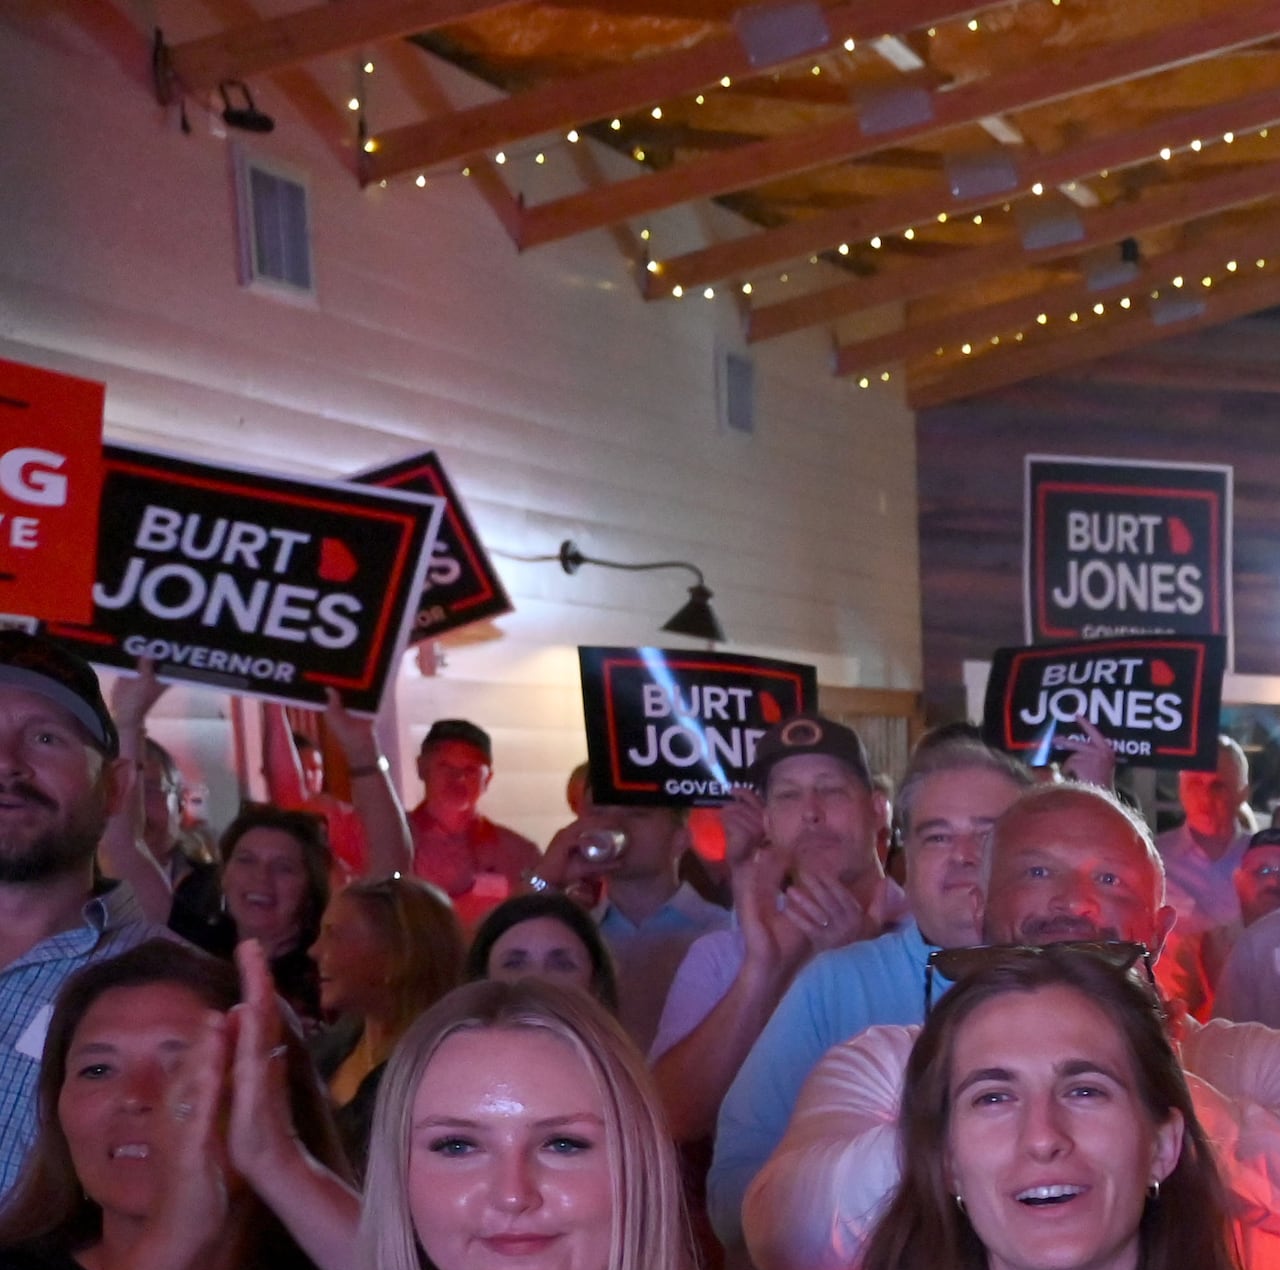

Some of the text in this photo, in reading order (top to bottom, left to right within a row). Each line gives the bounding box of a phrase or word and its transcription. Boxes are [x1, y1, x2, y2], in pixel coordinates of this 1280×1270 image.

[136, 504, 310, 575] BURT
[1067, 511, 1162, 554] BURT
[92, 556, 362, 650] JONES
[1053, 560, 1204, 615] JONES
[123, 634, 295, 685] GOVERNOR
[1041, 658, 1143, 687] BURT
[643, 683, 753, 721] BURT
[1020, 688, 1183, 732] JONES
